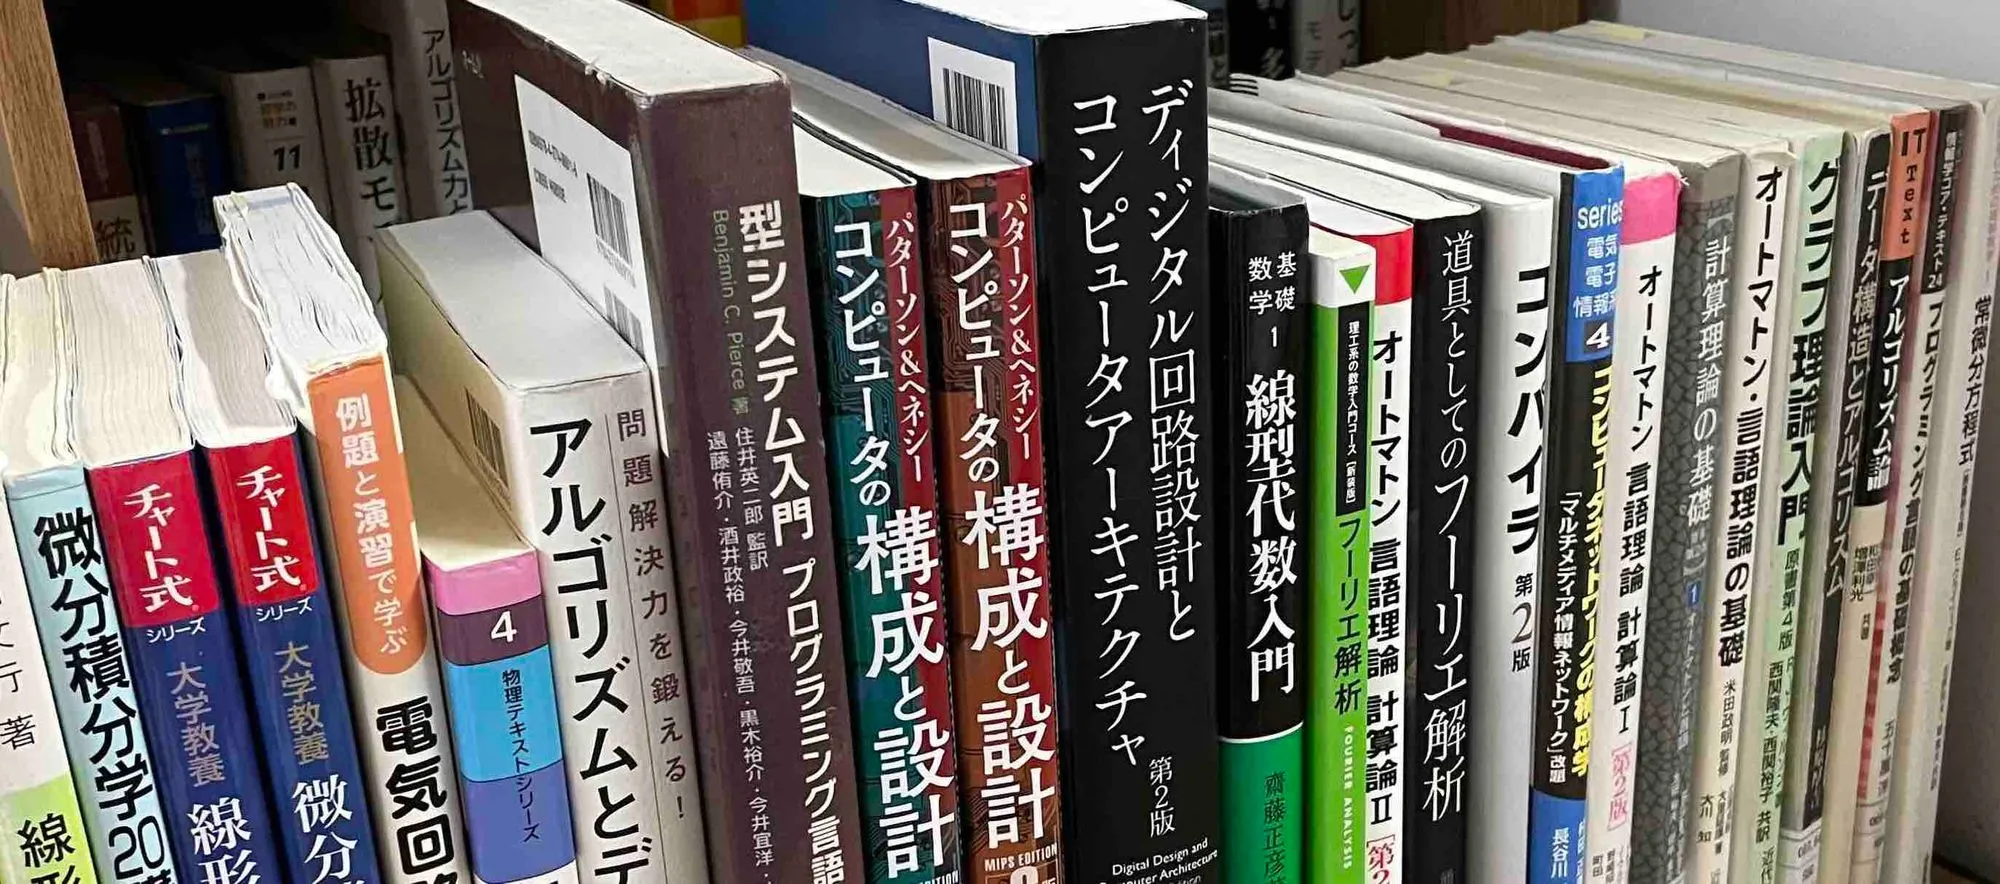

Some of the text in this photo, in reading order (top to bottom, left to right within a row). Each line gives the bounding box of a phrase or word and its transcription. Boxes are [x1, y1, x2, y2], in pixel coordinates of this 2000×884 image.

[273, 144, 301, 172] 11
[345, 77, 398, 229] 拡散モ
[1900, 128, 1926, 244] IT Text
[713, 208, 738, 298] Benjamin
[1248, 255, 1273, 316] 数学
[1275, 251, 1297, 312] 基礎
[1585, 262, 1616, 288] 電子
[1587, 233, 1618, 259] 電気
[723, 304, 740, 324] C.
[727, 331, 745, 390] Pierce
[886, 211, 930, 482] パターソン&ヘネシー
[1001, 193, 1039, 460] パターソン&ヘネシー
[1142, 79, 1202, 641] ディジタル回路設計と
[1586, 321, 1611, 349] 4
[1631, 265, 1663, 453] オートマトン
[1778, 158, 1840, 545] グラフ理論入門
[1072, 94, 1147, 767] コンピュータアーキテクチャ
[1371, 331, 1403, 527] オートマトン
[1718, 166, 1782, 667] オートマトン・言語理論の基礎
[124, 483, 193, 613] チャート式
[236, 465, 301, 593] チャート式
[335, 392, 409, 656] 例題と演習で学ぶ
[735, 426, 769, 571] 住井英二郎 監訳
[739, 200, 845, 884] 型システム入門 プログラミング言語
[834, 221, 954, 878] コンピュータの構成と設計
[950, 203, 1055, 848] コンピュータの構成と設計
[1245, 370, 1298, 701] 線型代数入門
[1423, 229, 1475, 821] 道具としてのフーリエ解析
[1619, 462, 1651, 598] 言語理論
[145, 615, 207, 645] シリーズ
[256, 596, 313, 622] シリーズ
[530, 417, 653, 884] アルゴリズムとデ
[1334, 518, 1362, 716] フーリエ解析
[1367, 538, 1401, 680] 言語理論
[1511, 573, 1534, 673] 第2版
[1613, 609, 1643, 707] 計算論
[166, 662, 226, 788] 大学教養
[274, 640, 359, 884] 大学教養 微分
[377, 696, 458, 884] 電気回
[491, 611, 541, 843] 4 物理テキストシリーズ
[1366, 690, 1399, 793] 計算論
[985, 842, 1057, 872] MIPS EDITION
[1112, 837, 1208, 876] Digital Design and
[1148, 755, 1176, 838] 第2版
[1343, 797, 1353, 870] ANALYSIS
[1551, 827, 1570, 879] 長谷川
[1159, 849, 1218, 881] Architecture
